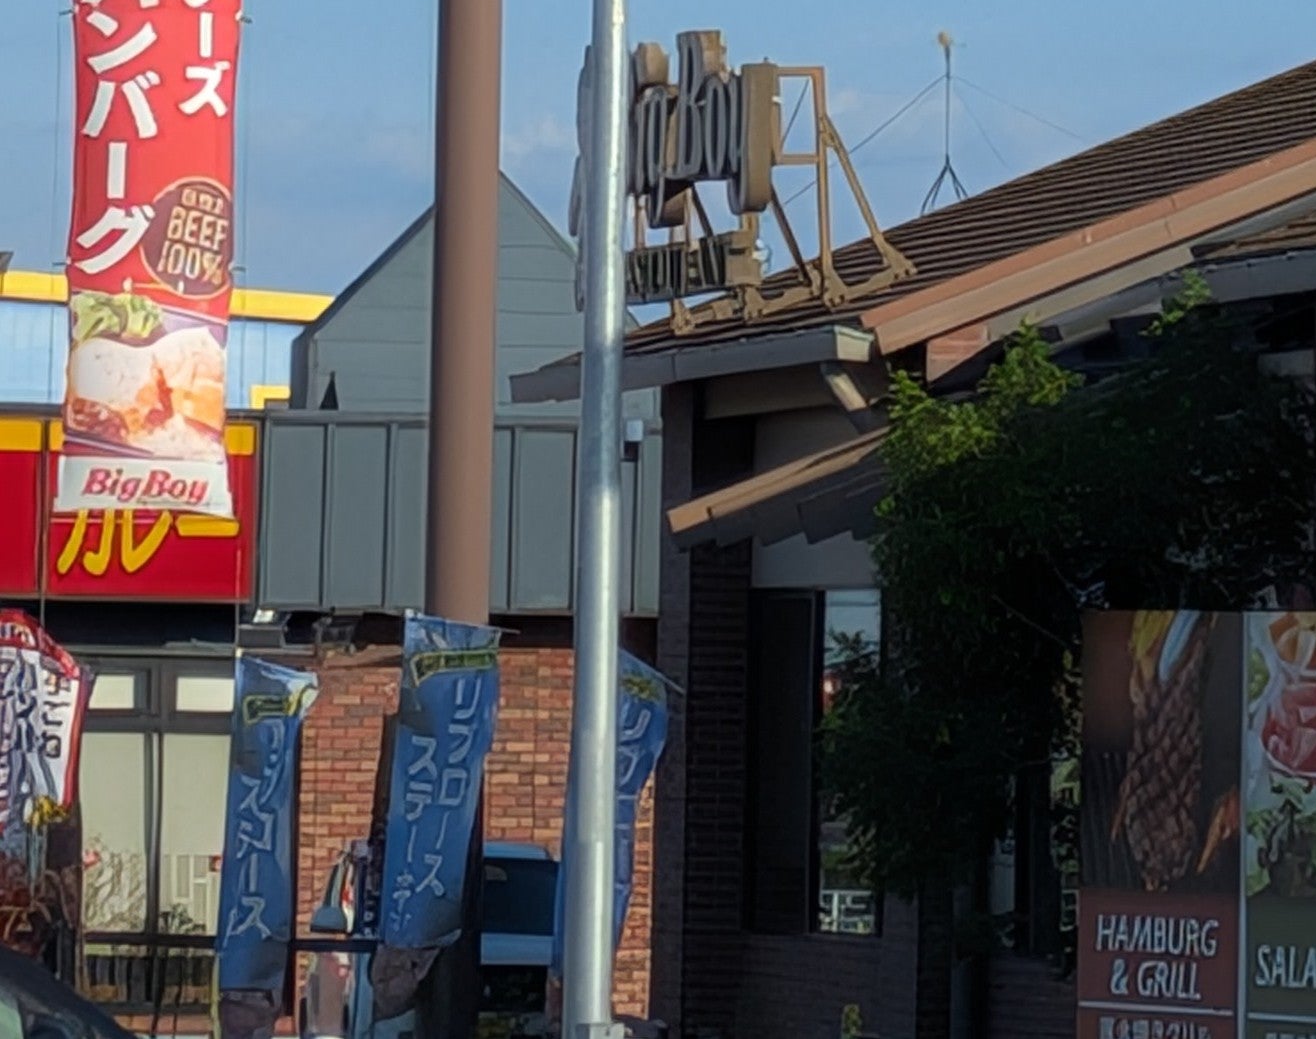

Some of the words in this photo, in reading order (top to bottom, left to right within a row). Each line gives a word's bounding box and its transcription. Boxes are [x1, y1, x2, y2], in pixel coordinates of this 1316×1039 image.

[167, 206, 229, 250] BEEF
[157, 241, 223, 285] 100%
[1096, 914, 1218, 956] HAMBURG
[1111, 960, 1128, 995] &
[1138, 961, 1201, 999] GRILL
